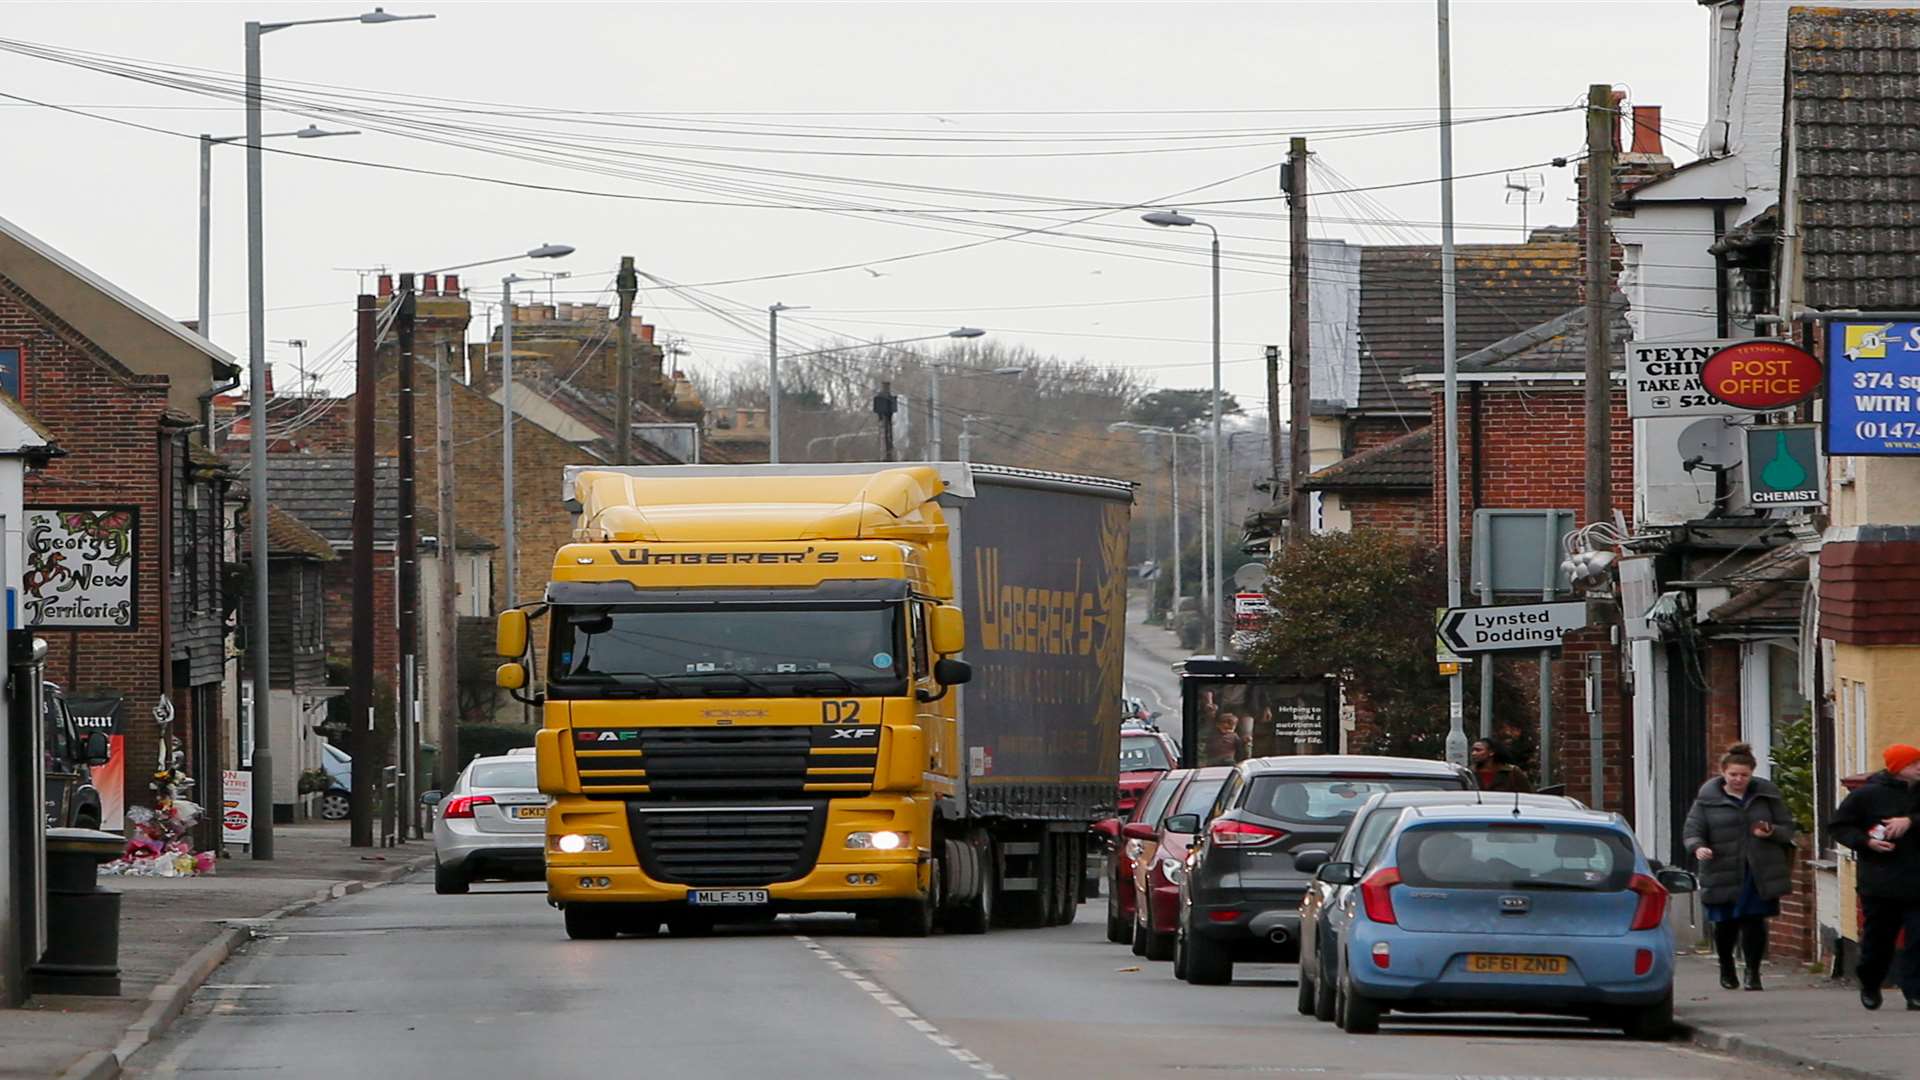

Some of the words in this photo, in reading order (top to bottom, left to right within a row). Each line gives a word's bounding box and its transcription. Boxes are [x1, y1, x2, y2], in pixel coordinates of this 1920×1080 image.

[1731, 361, 1792, 376] POST
[1638, 380, 1680, 392] TAKE
[1720, 379, 1800, 394] OFFICE
[1853, 372, 1894, 388] 374
[1680, 395, 1729, 407] 520
[1855, 396, 1911, 412] WITH
[1752, 490, 1818, 502] CHEMIST
[27, 525, 118, 561] George
[609, 546, 839, 565] WABERER'S
[56, 563, 129, 592] New
[976, 546, 1094, 656] WABERER'S
[24, 595, 131, 625] Territories
[1475, 610, 1550, 628] Lynsted
[822, 701, 860, 724] D2
[578, 731, 638, 741] DAF
[830, 729, 876, 739] XF
[699, 892, 764, 902] MLF-519
[1475, 957, 1517, 971] GF61
